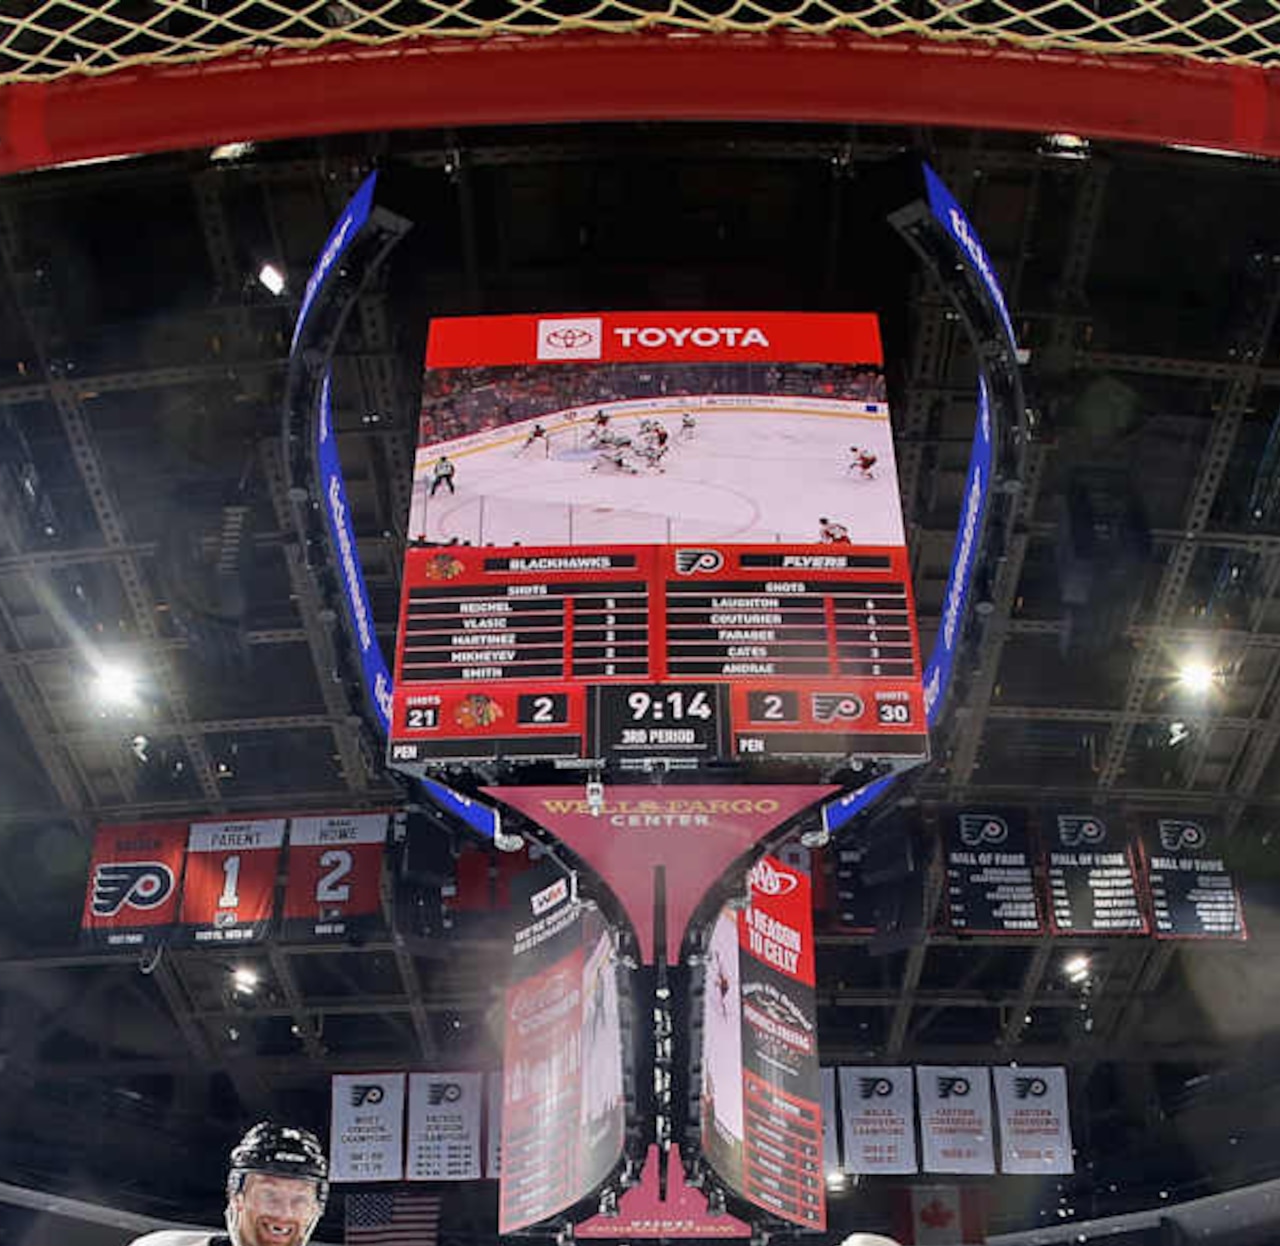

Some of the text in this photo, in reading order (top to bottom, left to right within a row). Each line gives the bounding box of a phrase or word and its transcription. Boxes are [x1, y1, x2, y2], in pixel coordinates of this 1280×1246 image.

[613, 325, 770, 349] TOYOTA
[508, 557, 612, 571] BLACKHAWKS
[782, 556, 848, 568] FLYERS
[506, 585, 548, 596] SHOTS
[765, 582, 806, 593] SHOTS
[532, 697, 554, 722] 2
[627, 692, 712, 720] 9:14
[763, 695, 784, 719] 2
[880, 705, 908, 722] 30
[408, 710, 436, 727] 21
[621, 729, 695, 744] 3RD PERIOD
[393, 745, 418, 759] PEN
[739, 738, 764, 753] PEN
[668, 799, 781, 814] FARGO
[610, 814, 710, 826] CENTER
[218, 854, 241, 908] 1
[316, 849, 353, 902] 2
